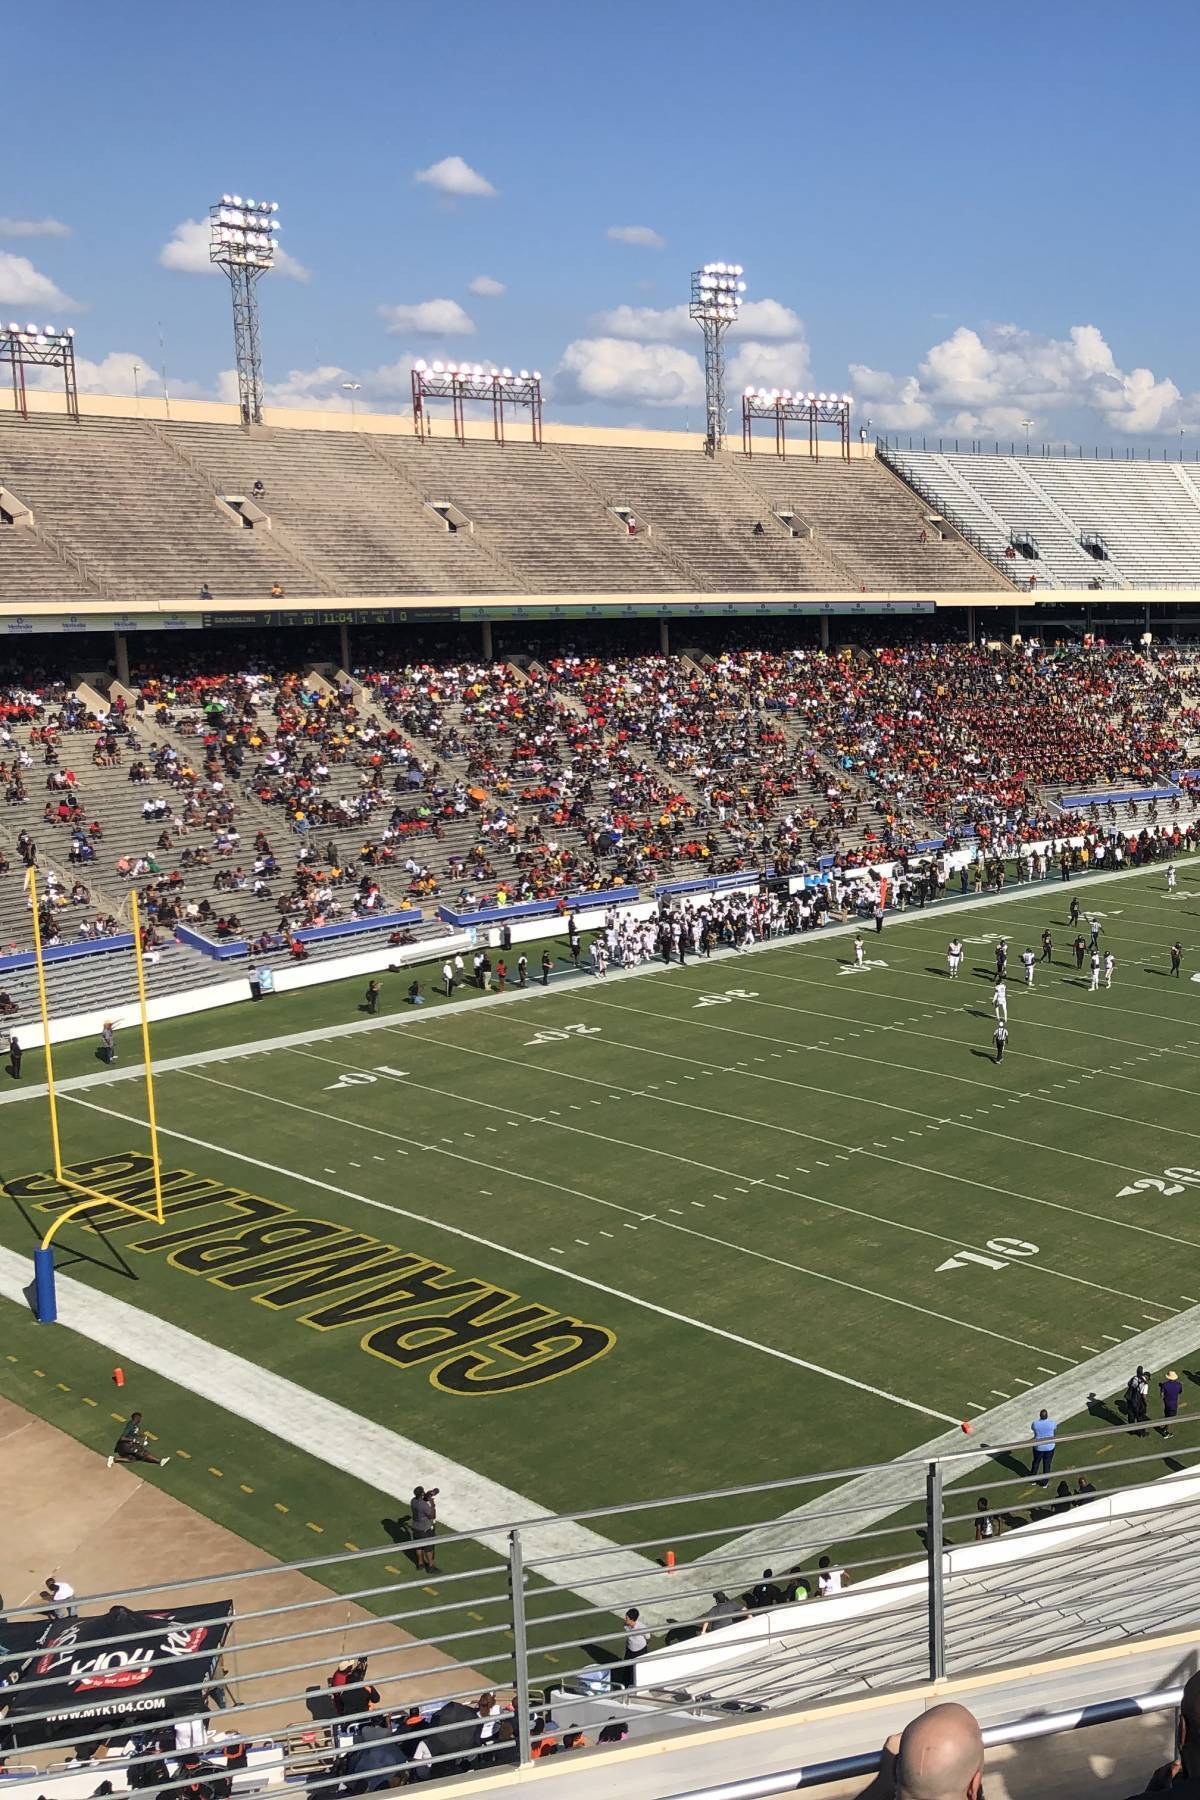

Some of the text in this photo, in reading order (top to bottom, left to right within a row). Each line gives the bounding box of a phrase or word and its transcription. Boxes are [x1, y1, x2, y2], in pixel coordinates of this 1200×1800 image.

[324, 613, 353, 623] 11:04
[699, 988, 760, 1005] 30
[532, 1022, 603, 1043] 20
[336, 1064, 411, 1087] 10
[953, 1237, 1040, 1271] 10
[2, 1150, 617, 1396] GRAMBLING
[67, 1647, 154, 1686] K104
